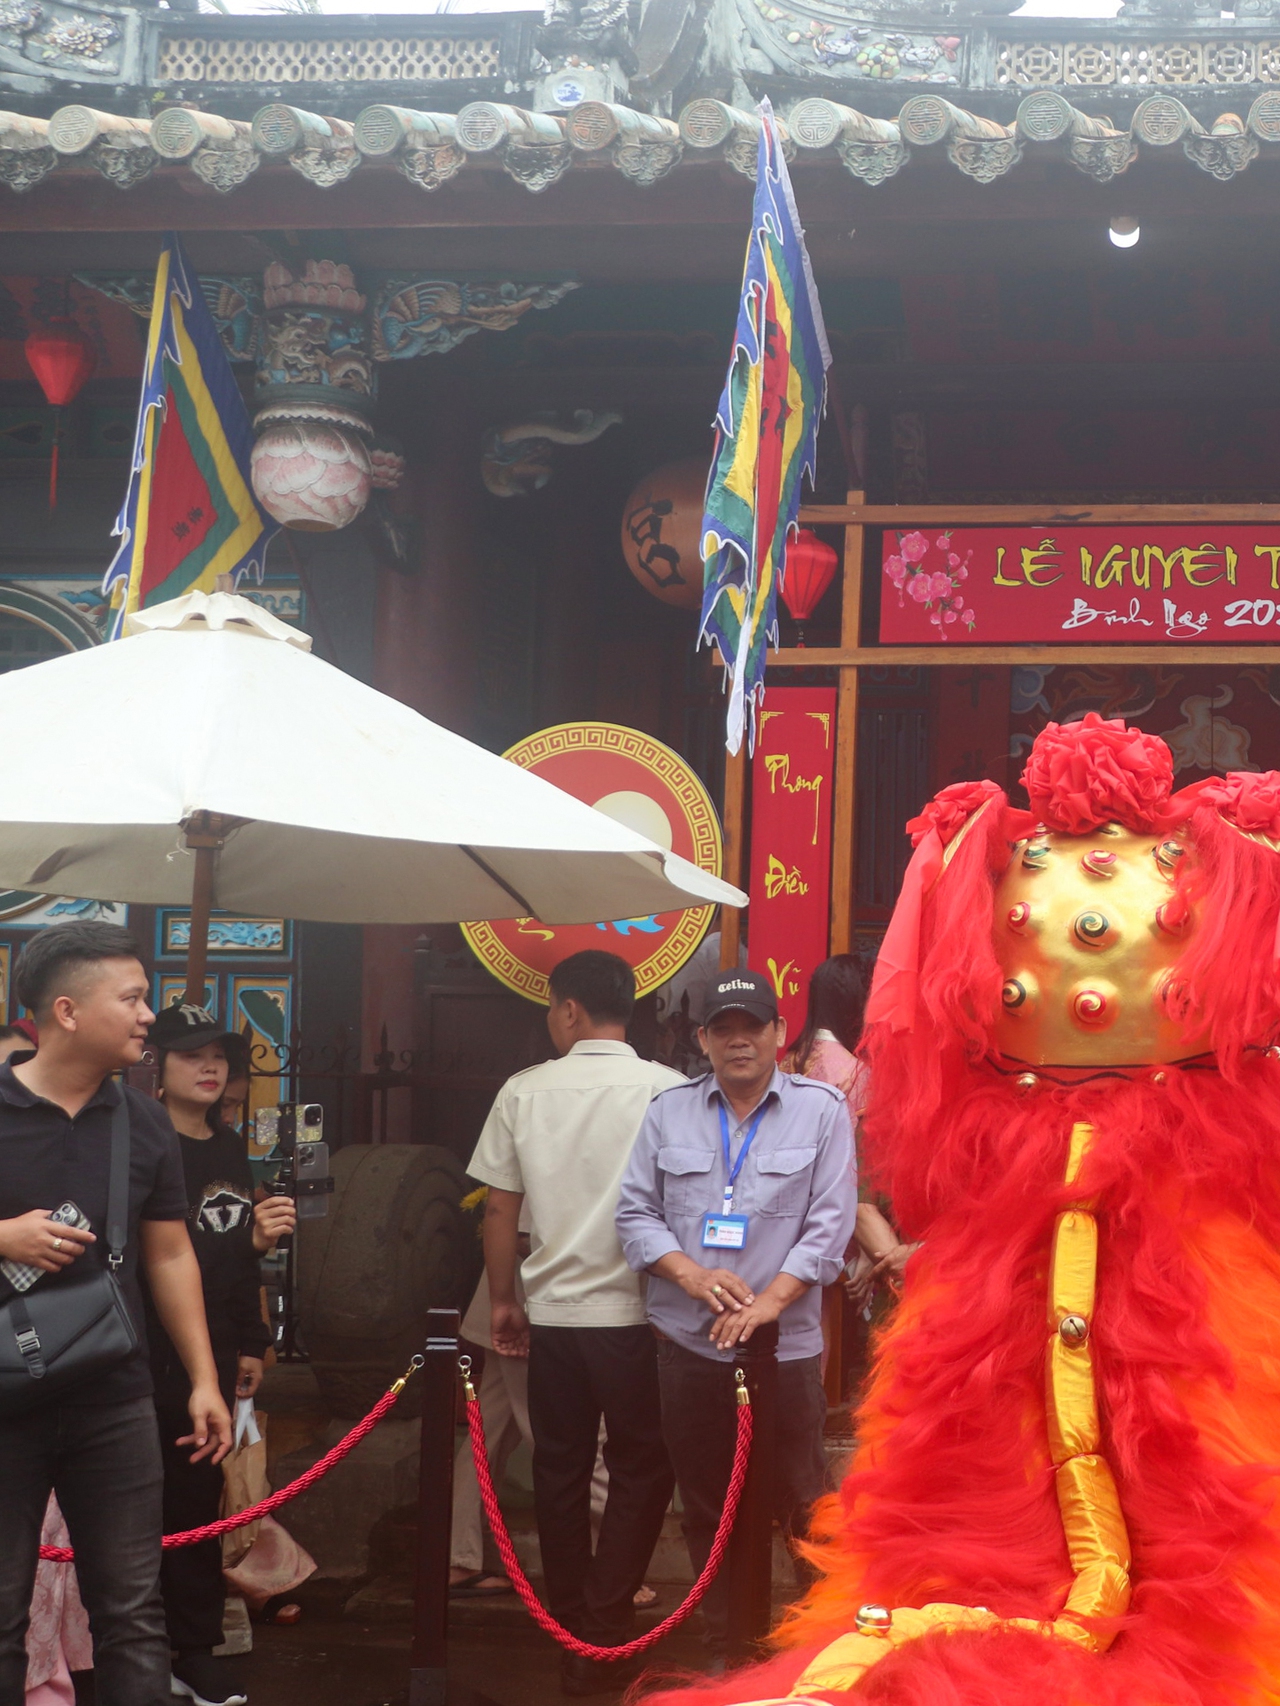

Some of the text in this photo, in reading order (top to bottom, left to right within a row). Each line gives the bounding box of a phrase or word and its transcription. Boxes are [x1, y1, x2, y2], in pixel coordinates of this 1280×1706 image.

[992, 538, 1064, 588] LỄ
[1079, 542, 1239, 591] NGUYÊN
[764, 753, 824, 999] Phong Điều Vũ
[717, 978, 756, 994] Celine
